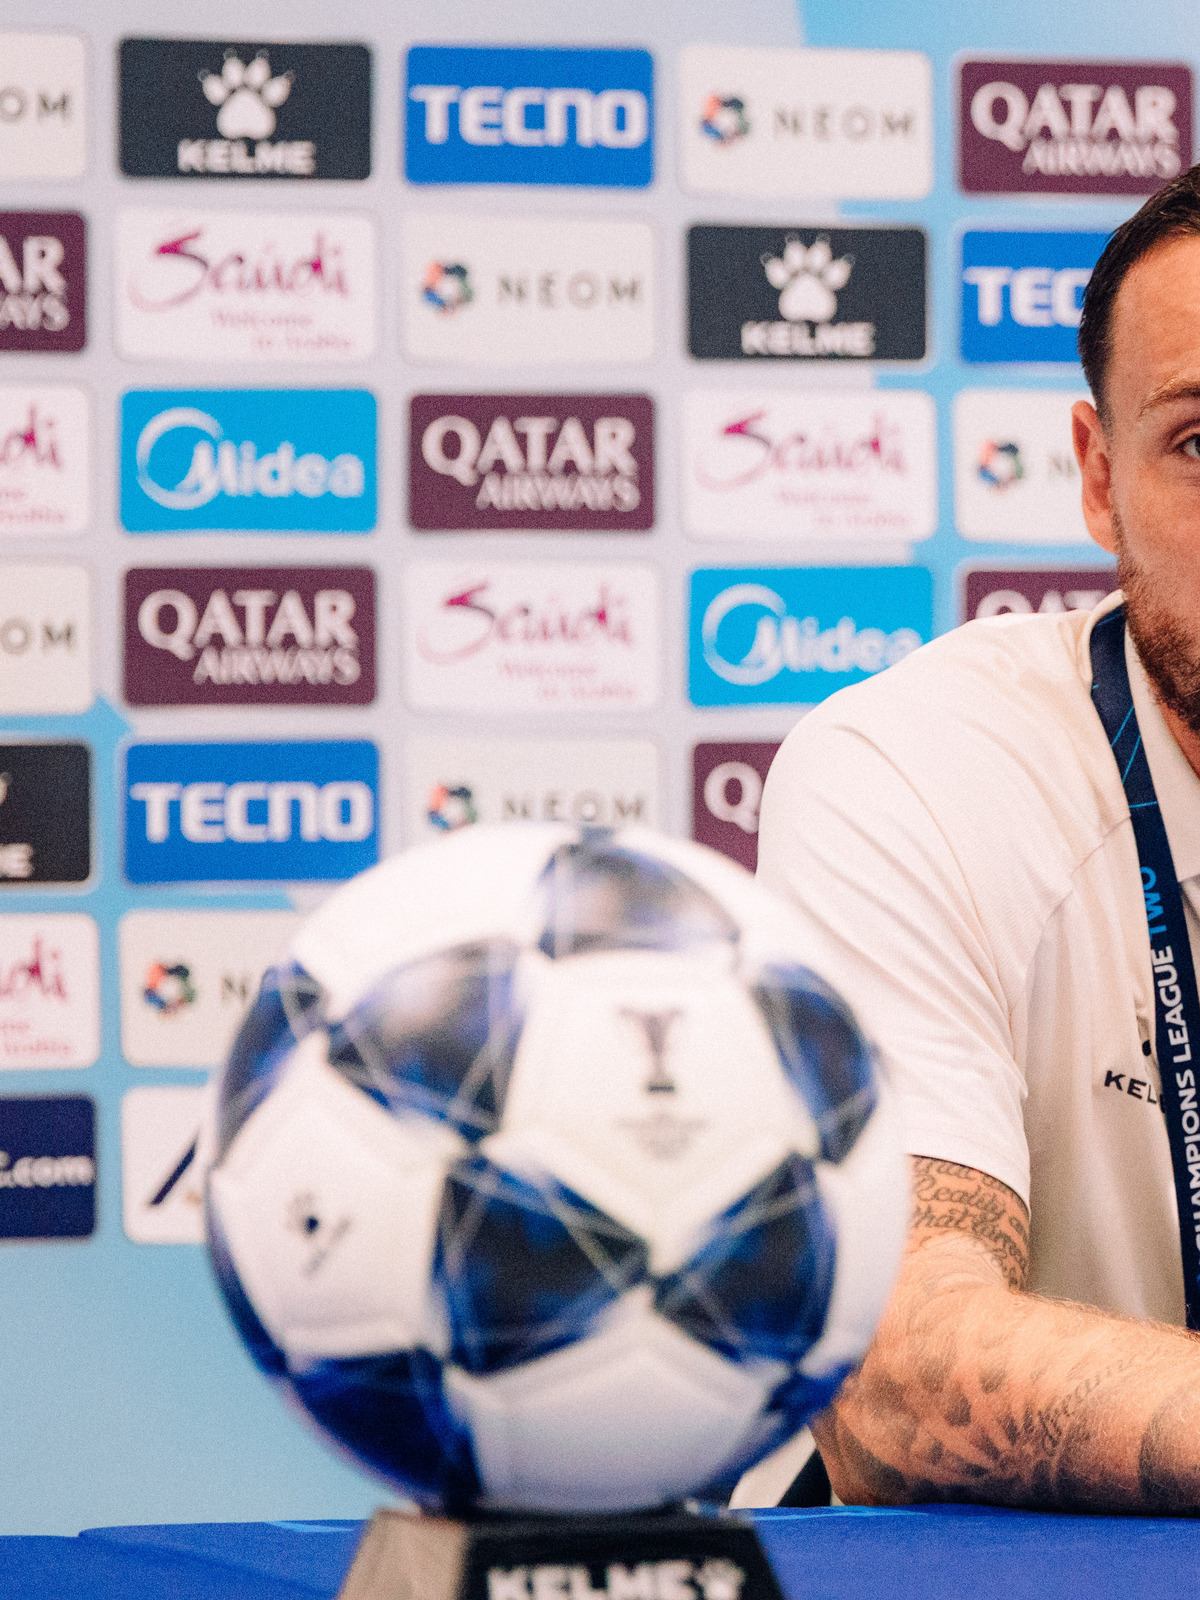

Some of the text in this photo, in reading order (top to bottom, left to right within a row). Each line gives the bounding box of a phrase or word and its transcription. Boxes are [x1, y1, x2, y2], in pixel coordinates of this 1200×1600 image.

[409, 84, 648, 148] TECNO
[772, 106, 914, 143] NEOM
[970, 81, 1178, 151] QATAR
[178, 139, 316, 176] KELME
[1020, 139, 1182, 179] AIRWAYS
[129, 229, 350, 312] Saudi
[499, 270, 642, 302] NEOM
[963, 266, 1083, 328] TEC
[740, 321, 875, 356] KELME
[155, 424, 366, 505] Midea
[421, 415, 637, 486] QATAR
[475, 472, 641, 511] AIRWAYS
[138, 588, 359, 660] QATAR
[193, 646, 362, 686] AIRWAYS
[130, 781, 374, 844] TECNO
[1140, 866, 1168, 942] TWO
[1151, 945, 1192, 1063] LEAGUE
[1104, 1070, 1158, 1105] KEL
